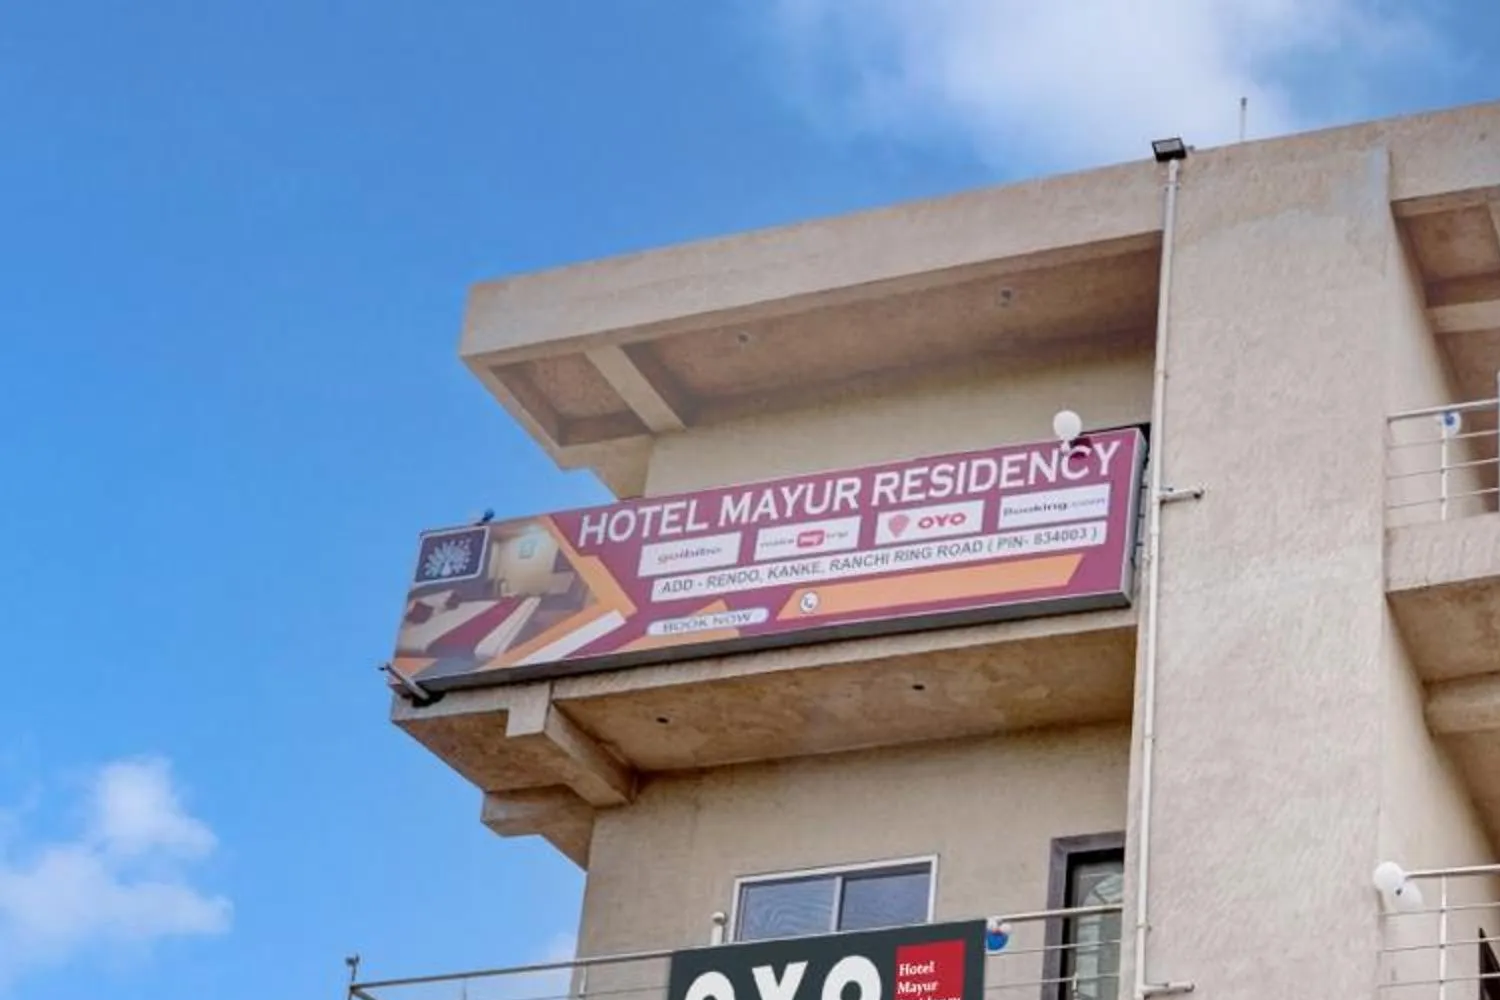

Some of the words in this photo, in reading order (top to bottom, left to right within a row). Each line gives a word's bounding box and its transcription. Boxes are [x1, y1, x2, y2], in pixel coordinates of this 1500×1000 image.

[578, 500, 707, 547] HOTEL
[718, 477, 860, 527] MAYUR
[870, 440, 1120, 506] RESIDENCY
[918, 512, 967, 529] OYO
[660, 579, 693, 593] ADD
[830, 553, 890, 571] RANCHI
[894, 546, 932, 562] RING
[937, 540, 983, 557] ROAD
[899, 960, 935, 977] Hotel
[897, 980, 939, 997] Mayur
